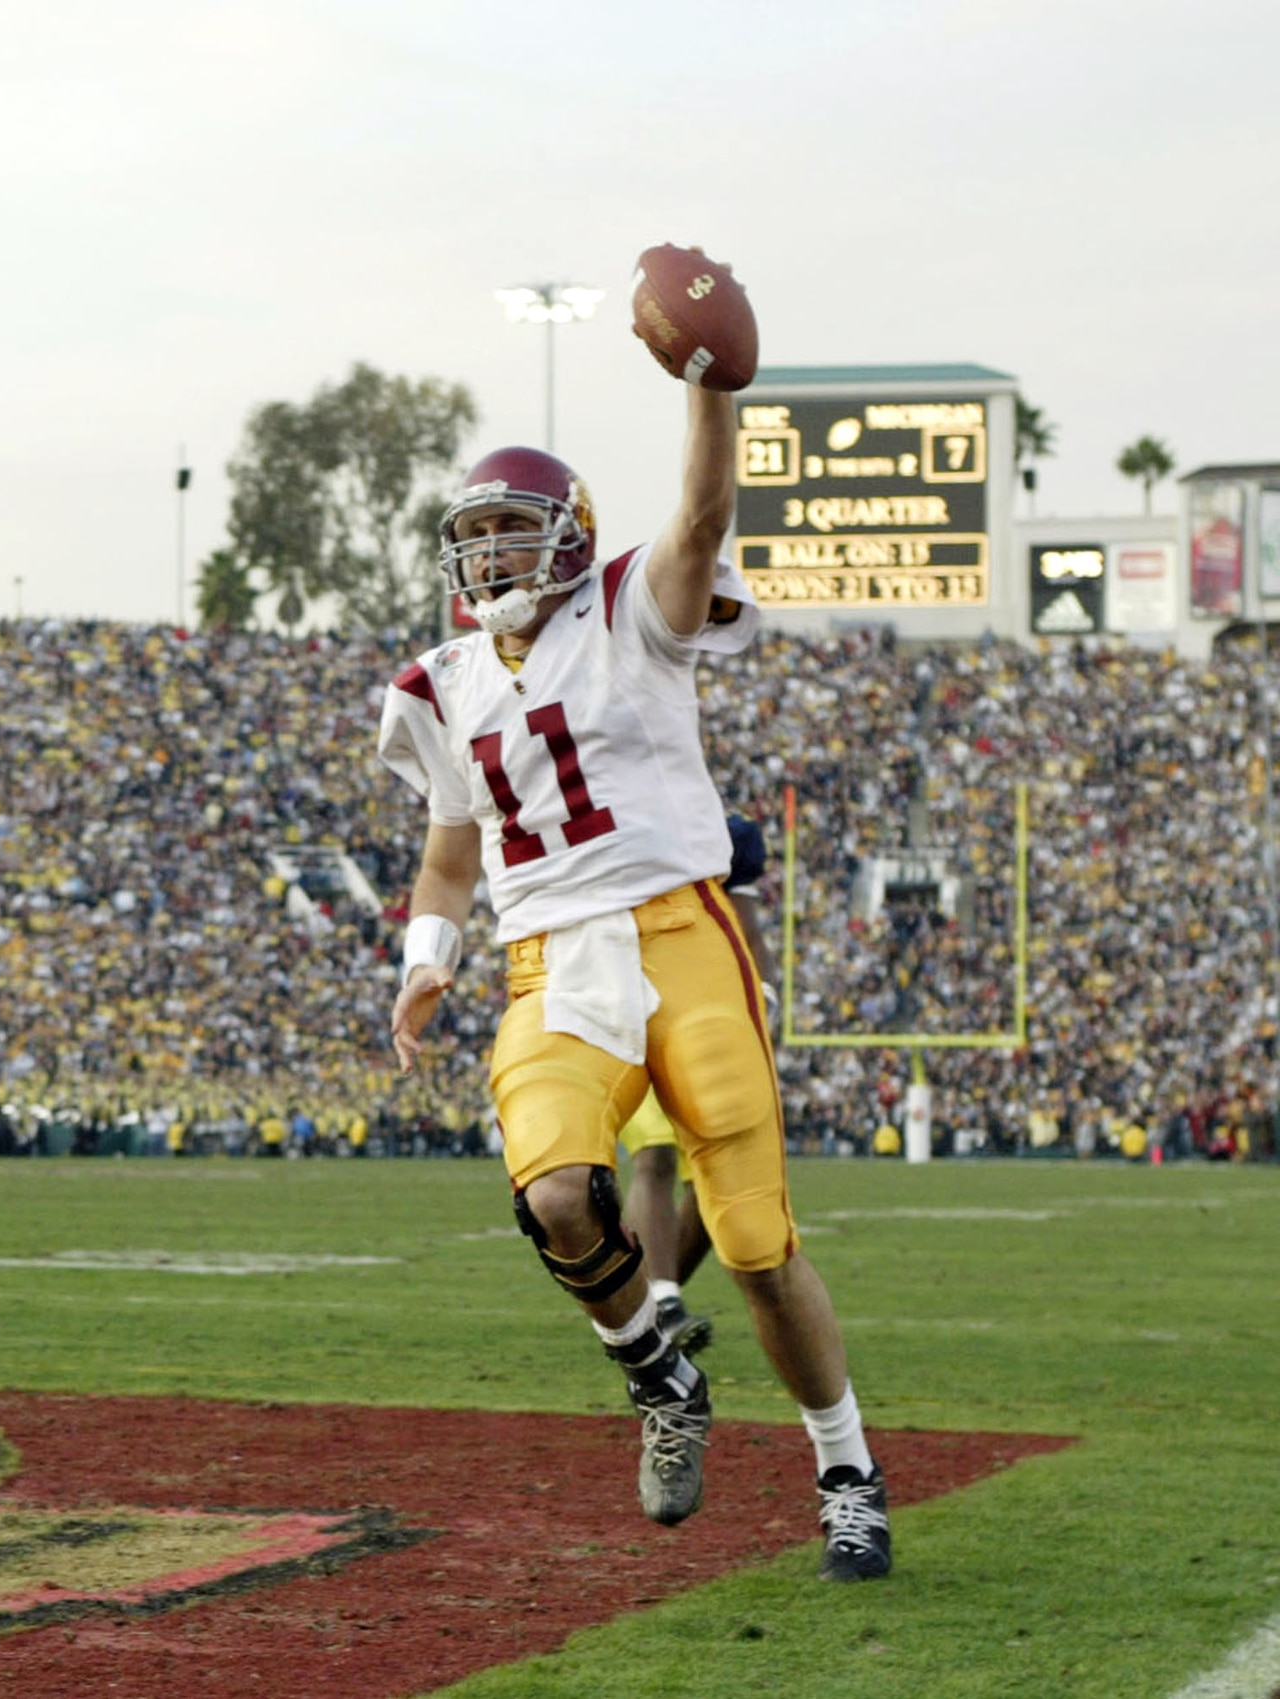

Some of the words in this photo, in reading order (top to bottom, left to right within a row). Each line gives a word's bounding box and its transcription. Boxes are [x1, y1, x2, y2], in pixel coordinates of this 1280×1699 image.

[748, 440, 784, 473] 21
[944, 437, 969, 470] 7
[783, 498, 805, 527] 3
[806, 496, 950, 532] QUARTER
[471, 701, 616, 868] 11
